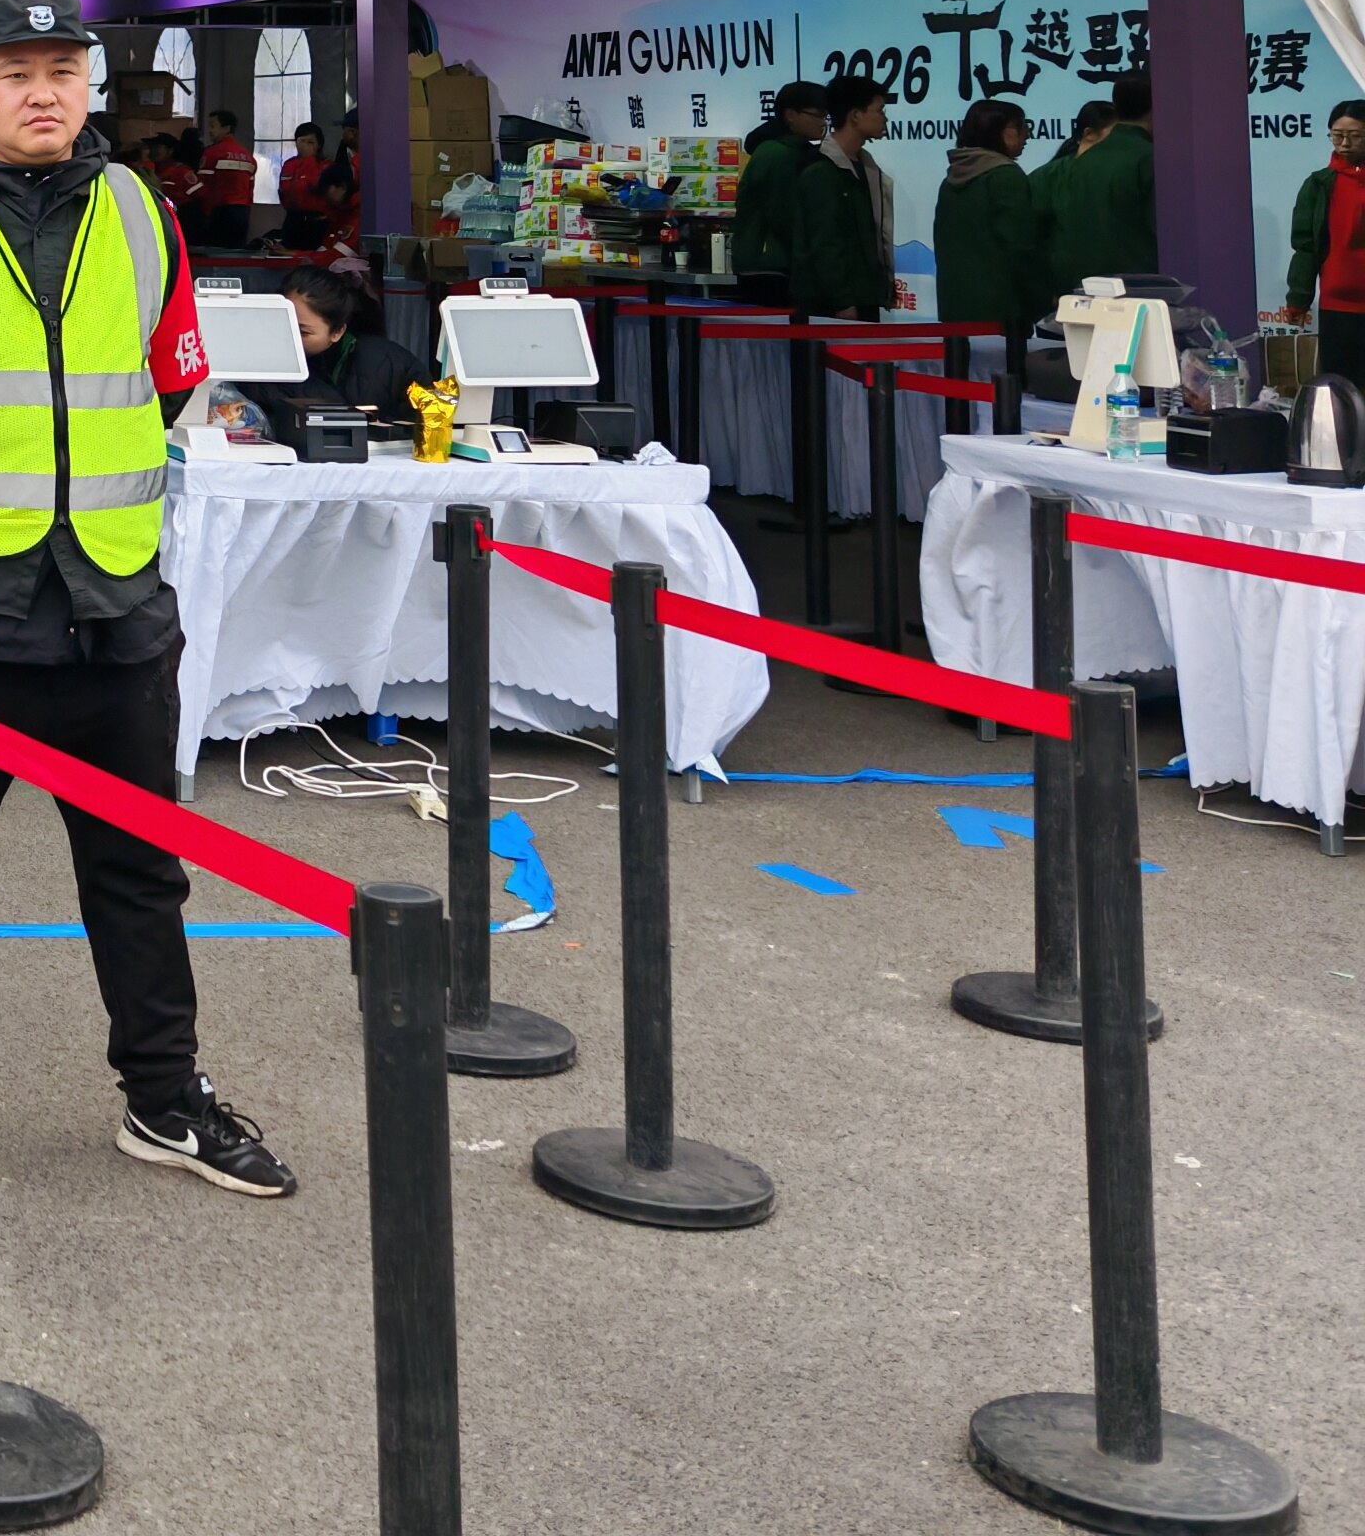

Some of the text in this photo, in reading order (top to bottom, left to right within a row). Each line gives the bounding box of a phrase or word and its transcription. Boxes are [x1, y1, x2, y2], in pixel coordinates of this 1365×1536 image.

[561, 18, 774, 79] ANTA GUANJUN
[1027, 118, 1066, 140] RAIL
[1251, 113, 1312, 139] ENGE
